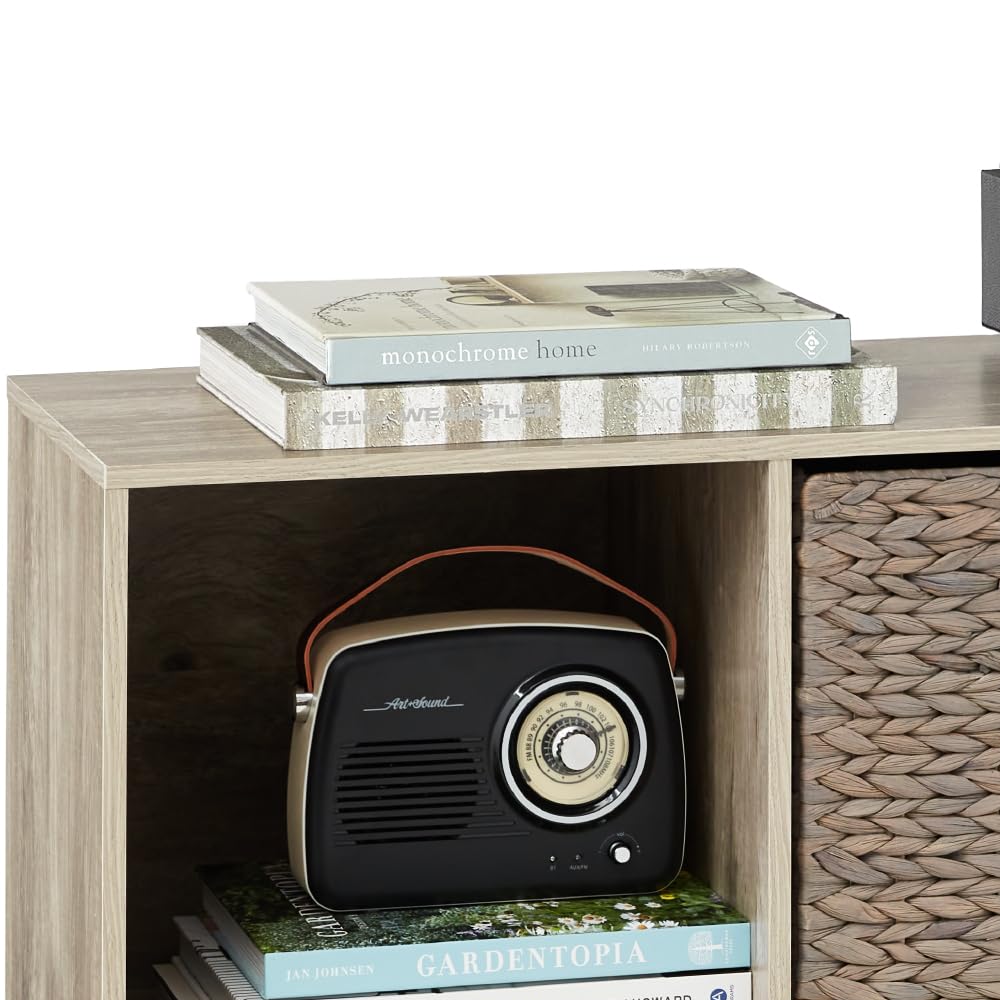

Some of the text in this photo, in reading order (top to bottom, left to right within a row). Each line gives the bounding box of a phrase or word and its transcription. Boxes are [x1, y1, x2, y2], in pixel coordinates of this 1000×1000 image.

[381, 339, 598, 365] monochrome home
[642, 340, 750, 353] HILARY ROBERTSON
[622, 391, 796, 415] SYNCHRONICIT
[530, 723, 538, 732] 90
[574, 700, 583, 708] 98
[586, 703, 597, 714] 100
[597, 711, 607, 722] 102
[416, 940, 648, 977] GARDENTOPIA
[286, 964, 375, 981] JAN JOHNSEN
